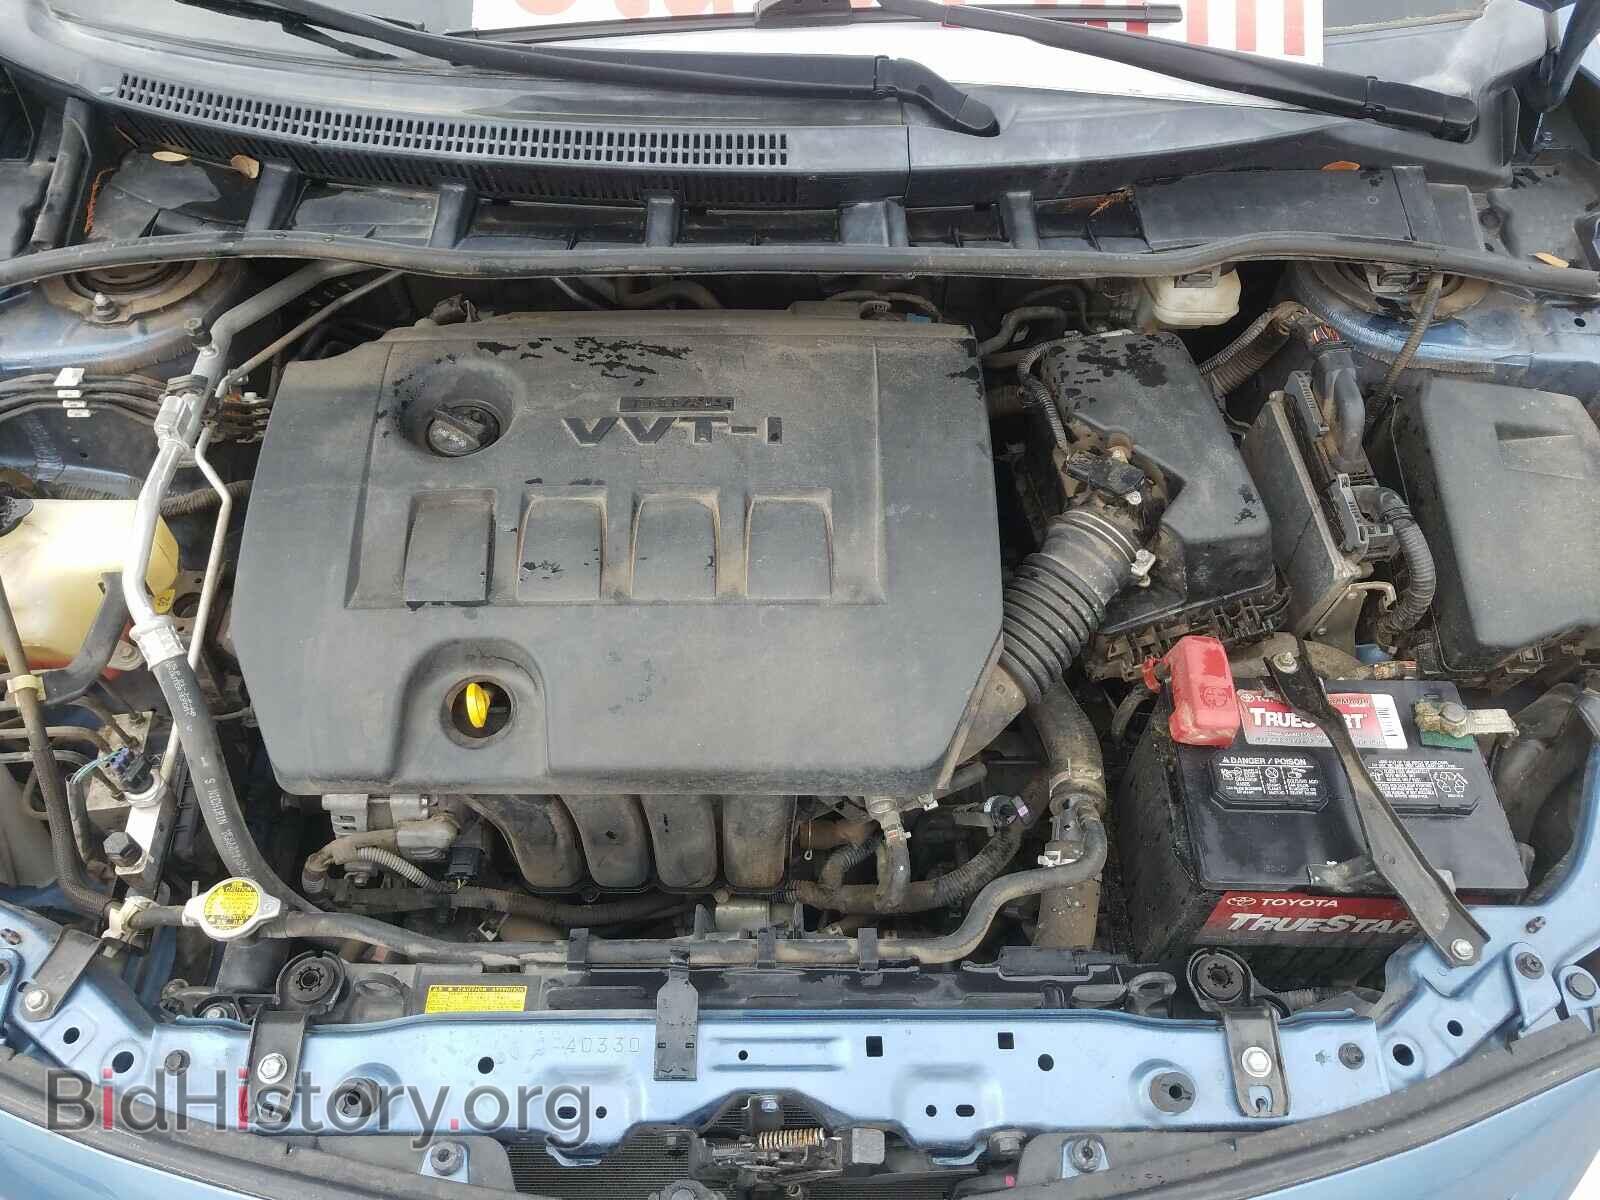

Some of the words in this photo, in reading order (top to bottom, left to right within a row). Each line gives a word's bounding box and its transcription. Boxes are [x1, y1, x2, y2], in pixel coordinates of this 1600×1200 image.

[1250, 708, 1364, 729] TRUERT
[1261, 898, 1338, 908] TOYOTA
[1226, 912, 1420, 934] TRUESTAR
